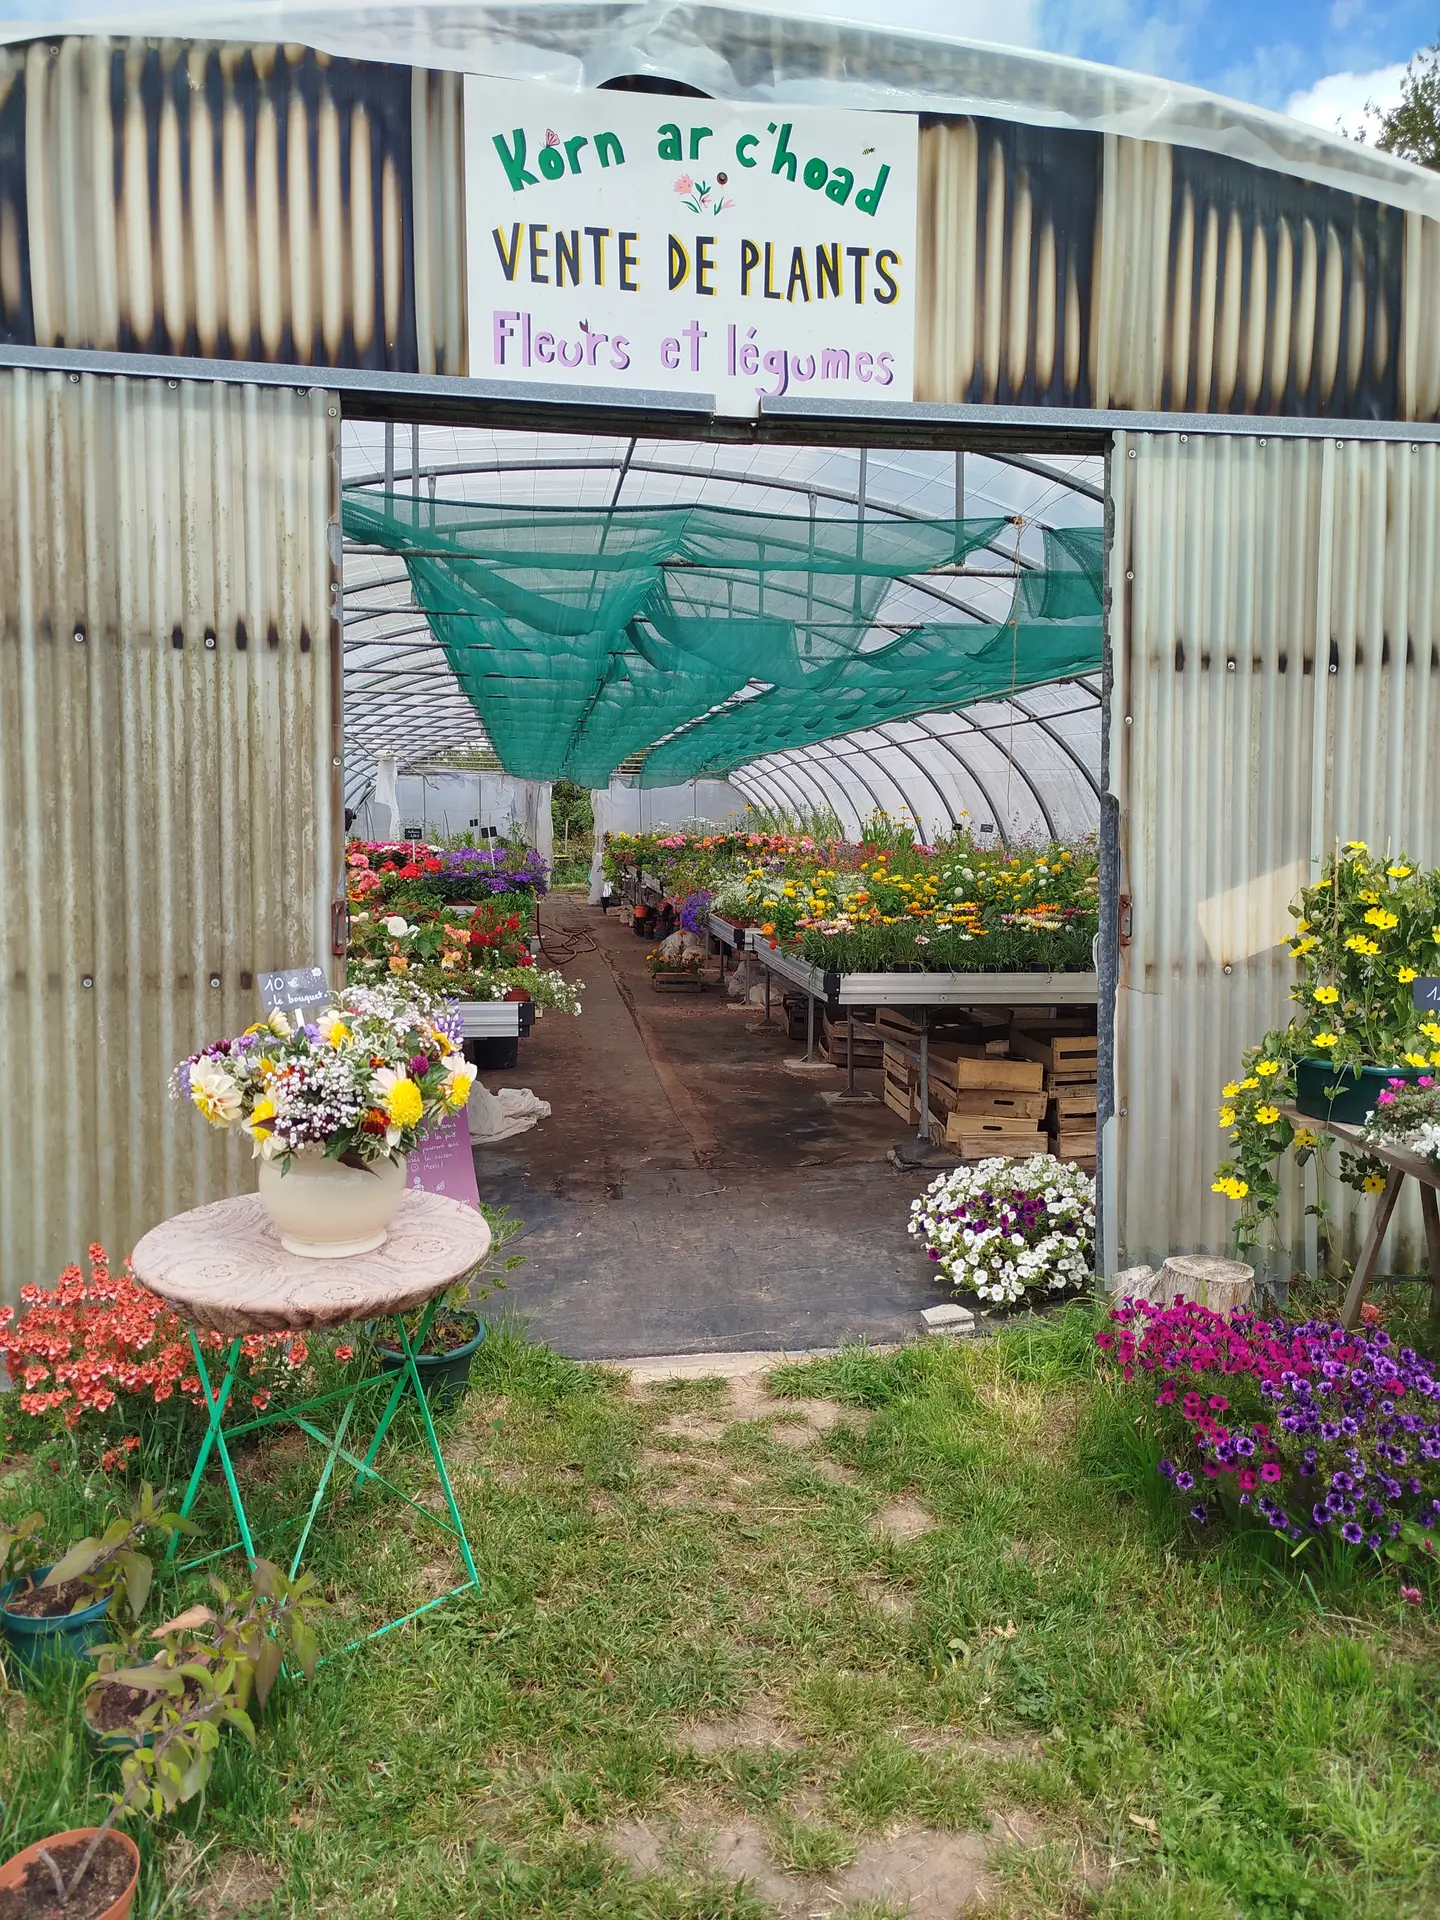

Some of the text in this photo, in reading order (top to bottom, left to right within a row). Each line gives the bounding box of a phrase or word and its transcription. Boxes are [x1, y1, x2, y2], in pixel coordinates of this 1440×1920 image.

[492, 122, 891, 217] Korn ar c'hoad
[492, 222, 903, 305] VENTE DE PLANTS
[493, 311, 895, 397] Fleurs et légumes
[264, 974, 284, 992] 10
